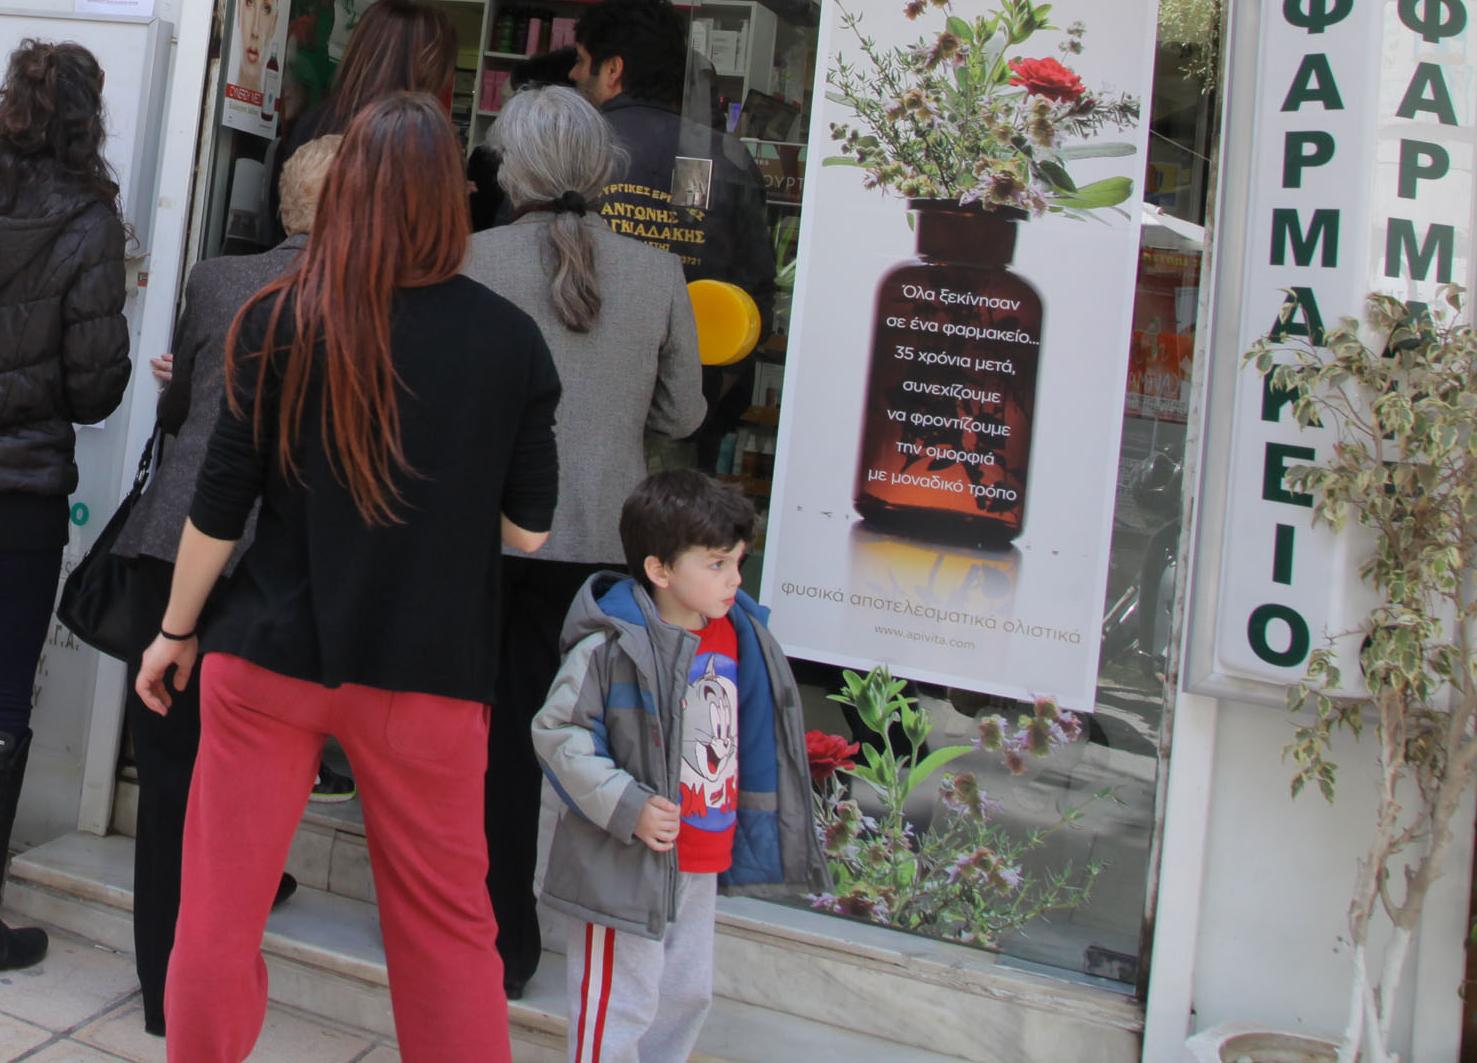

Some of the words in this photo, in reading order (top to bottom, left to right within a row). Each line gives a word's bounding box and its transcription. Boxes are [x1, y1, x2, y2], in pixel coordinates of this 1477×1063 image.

[901, 284, 936, 301] Όλα
[939, 288, 1021, 312] ξεκίνησαν
[885, 315, 907, 330] σε
[910, 318, 939, 333] ένα
[942, 323, 1041, 346] φαρμακείο...
[894, 345, 915, 361] 35
[917, 350, 972, 369] χρόνια
[975, 358, 1017, 377] μετά,
[902, 380, 1002, 405] συνεχίζουμε
[886, 409, 907, 422] να
[910, 411, 1012, 437] φροντίζουμε
[895, 440, 923, 456] την
[926, 445, 995, 466] ομορφιά
[867, 468, 888, 483] με
[891, 471, 965, 494] μοναδικό
[967, 483, 1018, 502] τρόπο
[781, 579, 844, 604] φυσικά
[849, 592, 997, 631] αποτελεσματικά
[1002, 617, 1082, 646] ολιστικά
[874, 623, 977, 651] www.apivita.com
